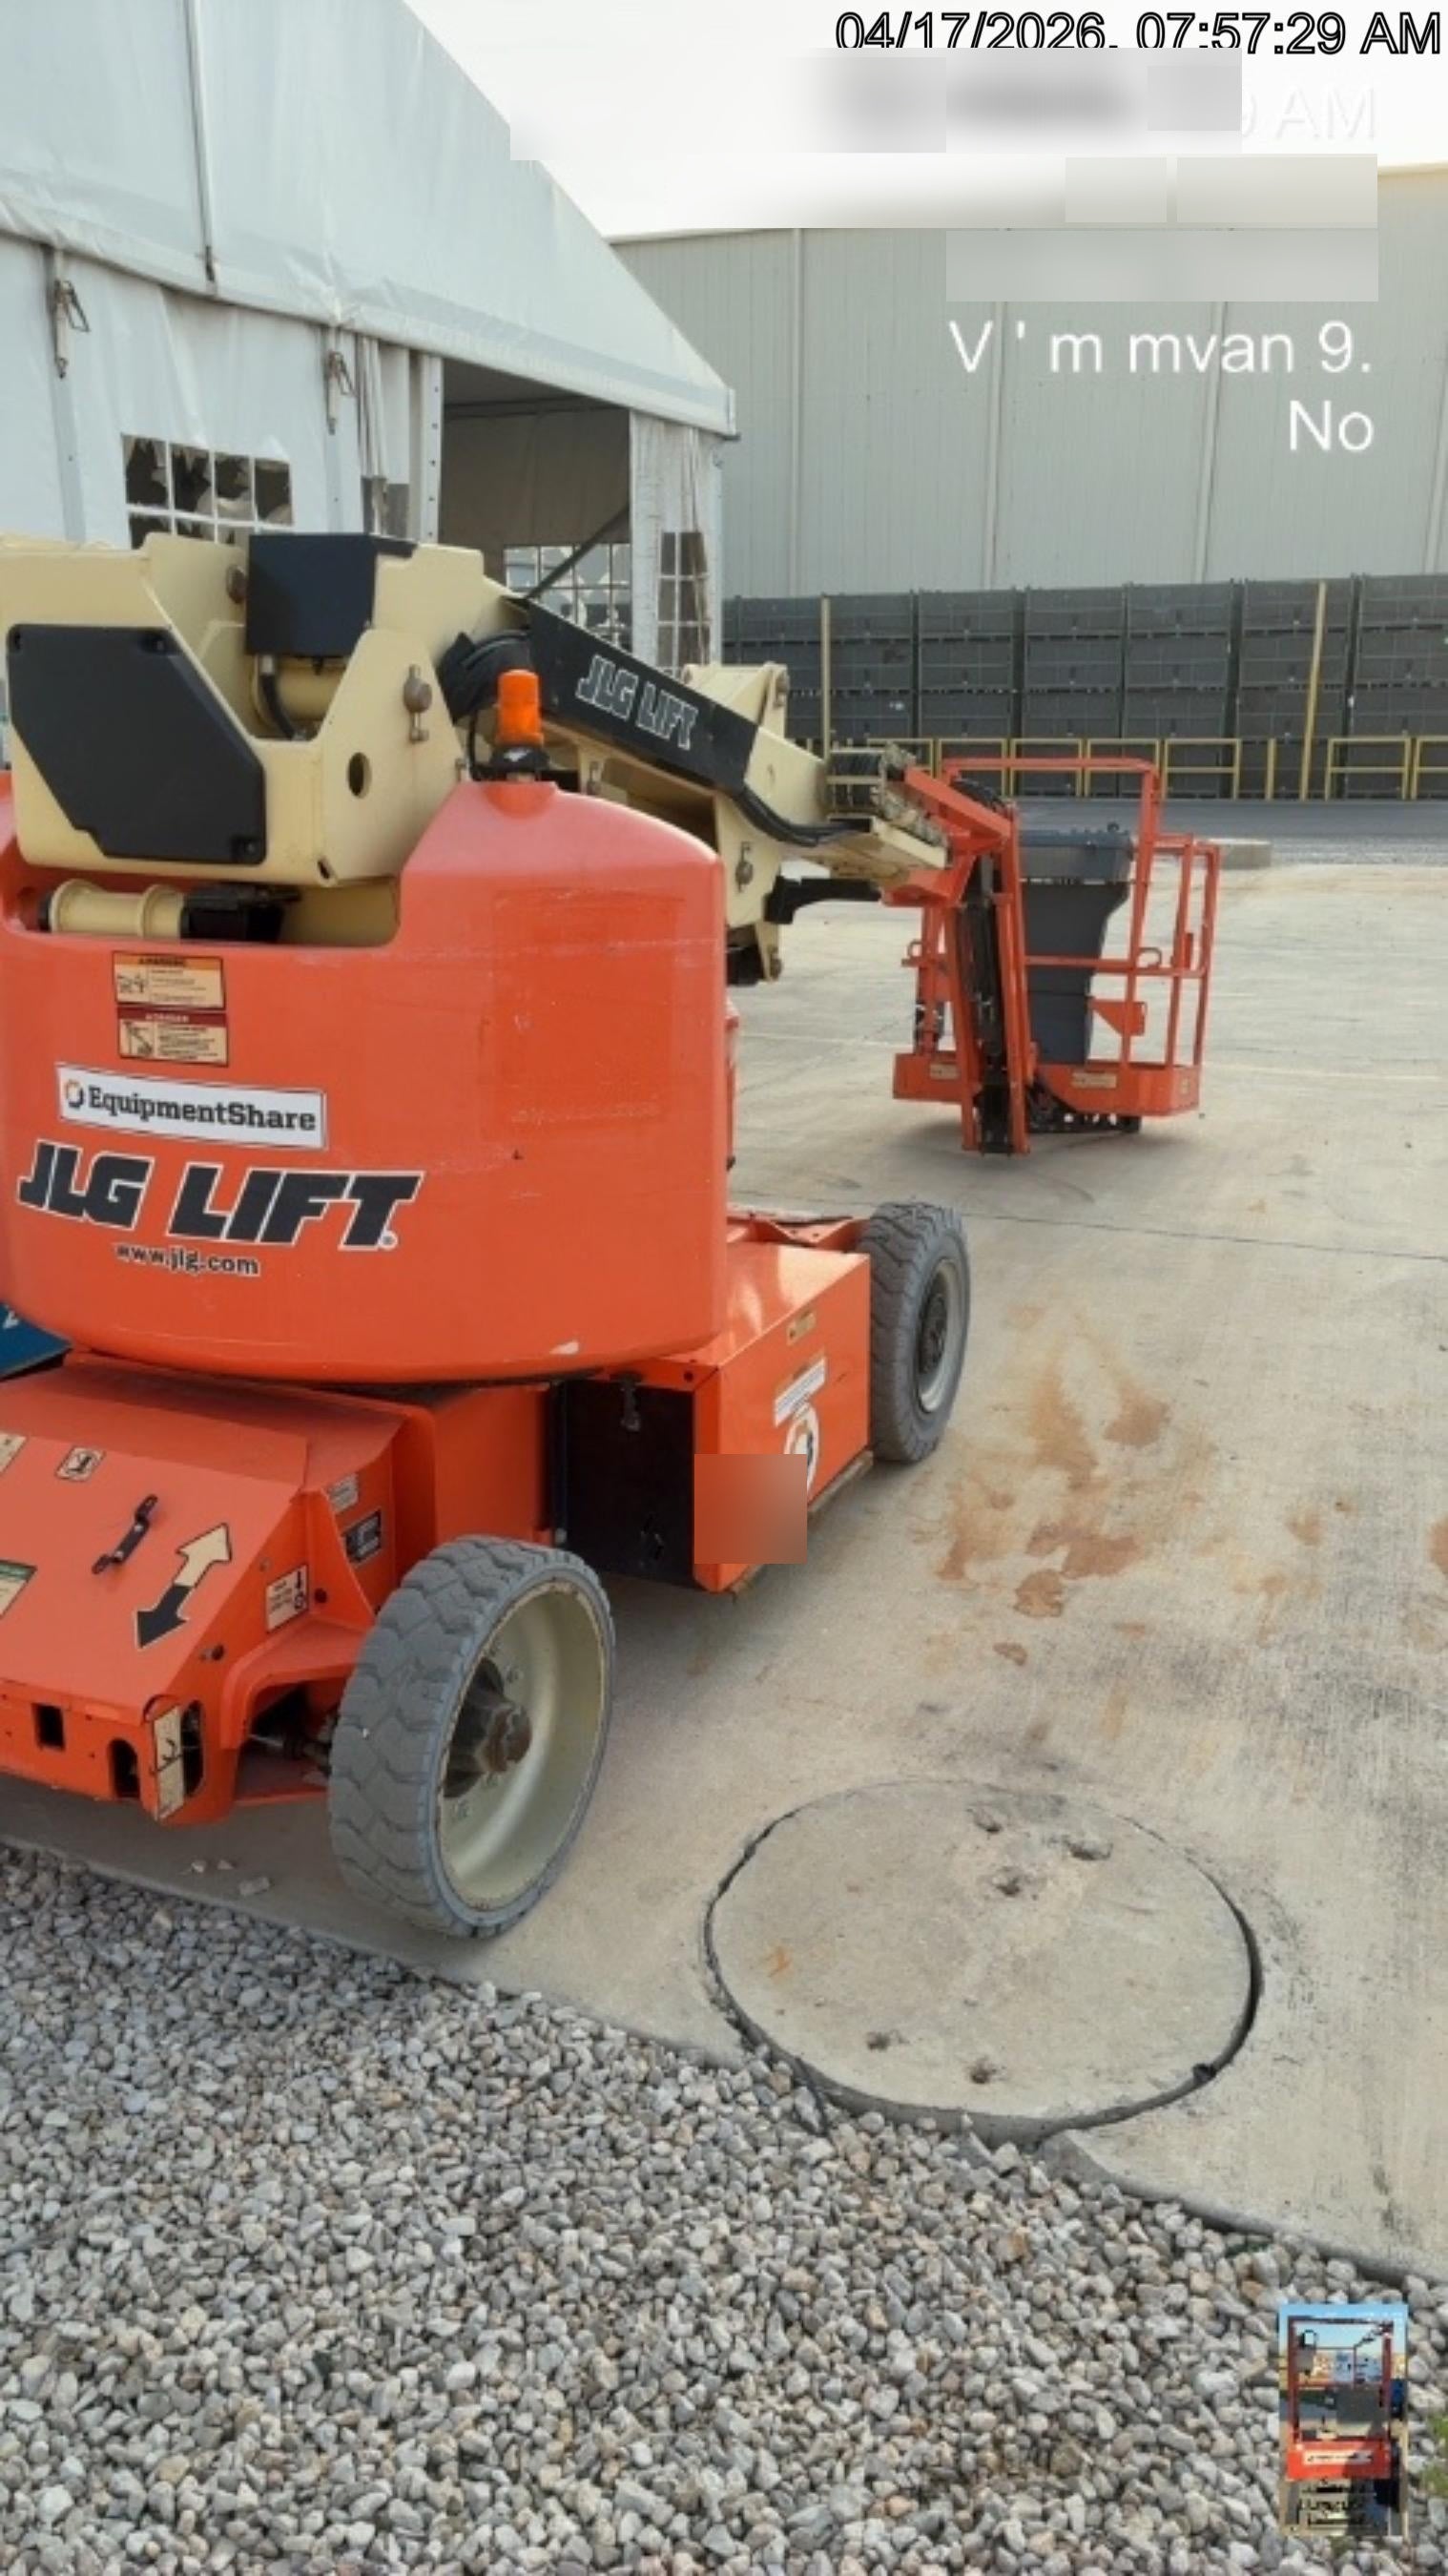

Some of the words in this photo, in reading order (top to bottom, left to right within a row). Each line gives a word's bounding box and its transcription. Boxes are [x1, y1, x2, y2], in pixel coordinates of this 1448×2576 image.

[575, 654, 638, 720] JLG
[635, 680, 699, 751] LIFT
[88, 1085, 317, 1132] EquipmentShare
[17, 1138, 155, 1229] JLG
[166, 1162, 425, 1250] LIFT
[115, 1242, 259, 1276] www.jlg.com
